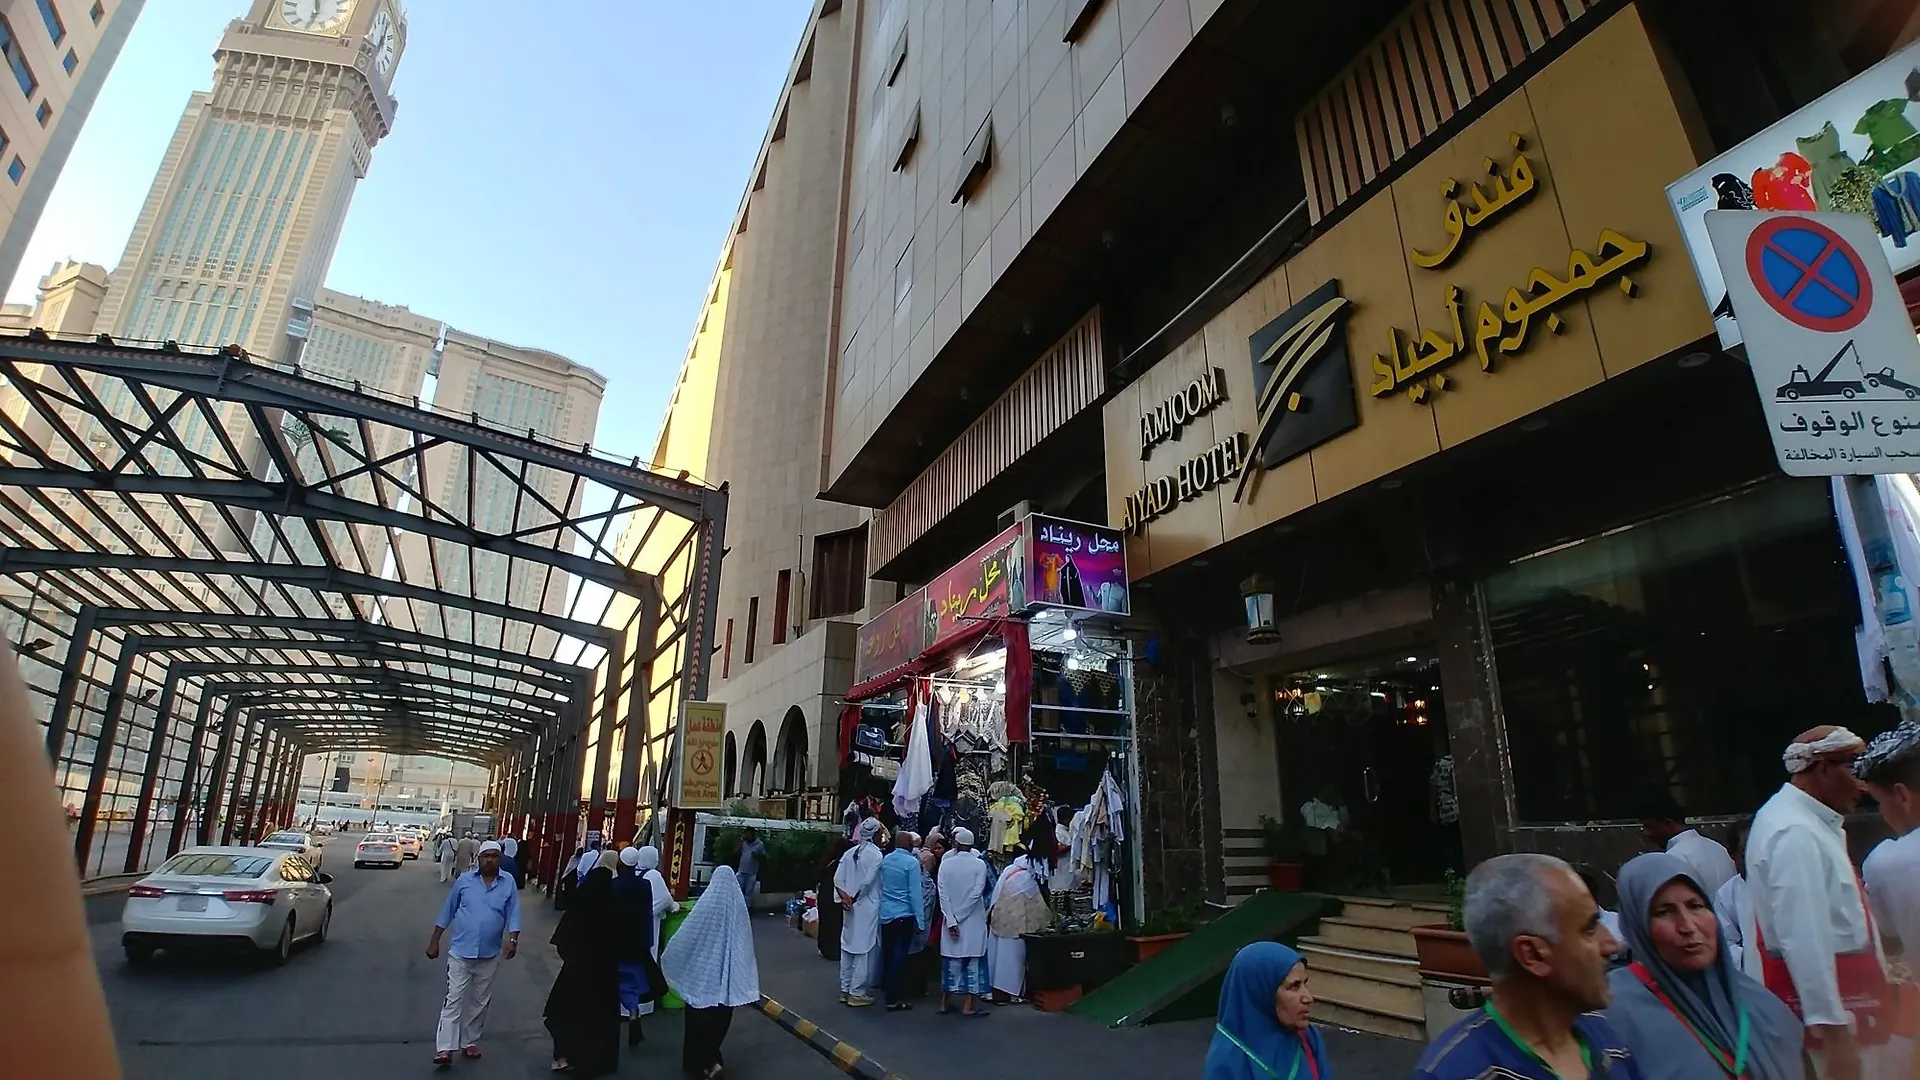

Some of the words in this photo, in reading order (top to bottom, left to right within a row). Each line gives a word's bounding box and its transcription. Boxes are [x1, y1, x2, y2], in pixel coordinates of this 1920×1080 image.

[1411, 131, 1536, 268] فندق
[1474, 228, 1650, 372] جمجوم
[1369, 284, 1466, 403] أجياد
[1139, 366, 1223, 461] JAMJOOM
[1780, 410, 1865, 437] الوقوف
[1121, 475, 1172, 536] AJYAD
[1176, 432, 1246, 502] HOTEL
[1784, 447, 1836, 461] المخالفة
[1840, 447, 1882, 462] السيارة
[1040, 524, 1082, 553] ريناد
[1088, 532, 1119, 554] محل
